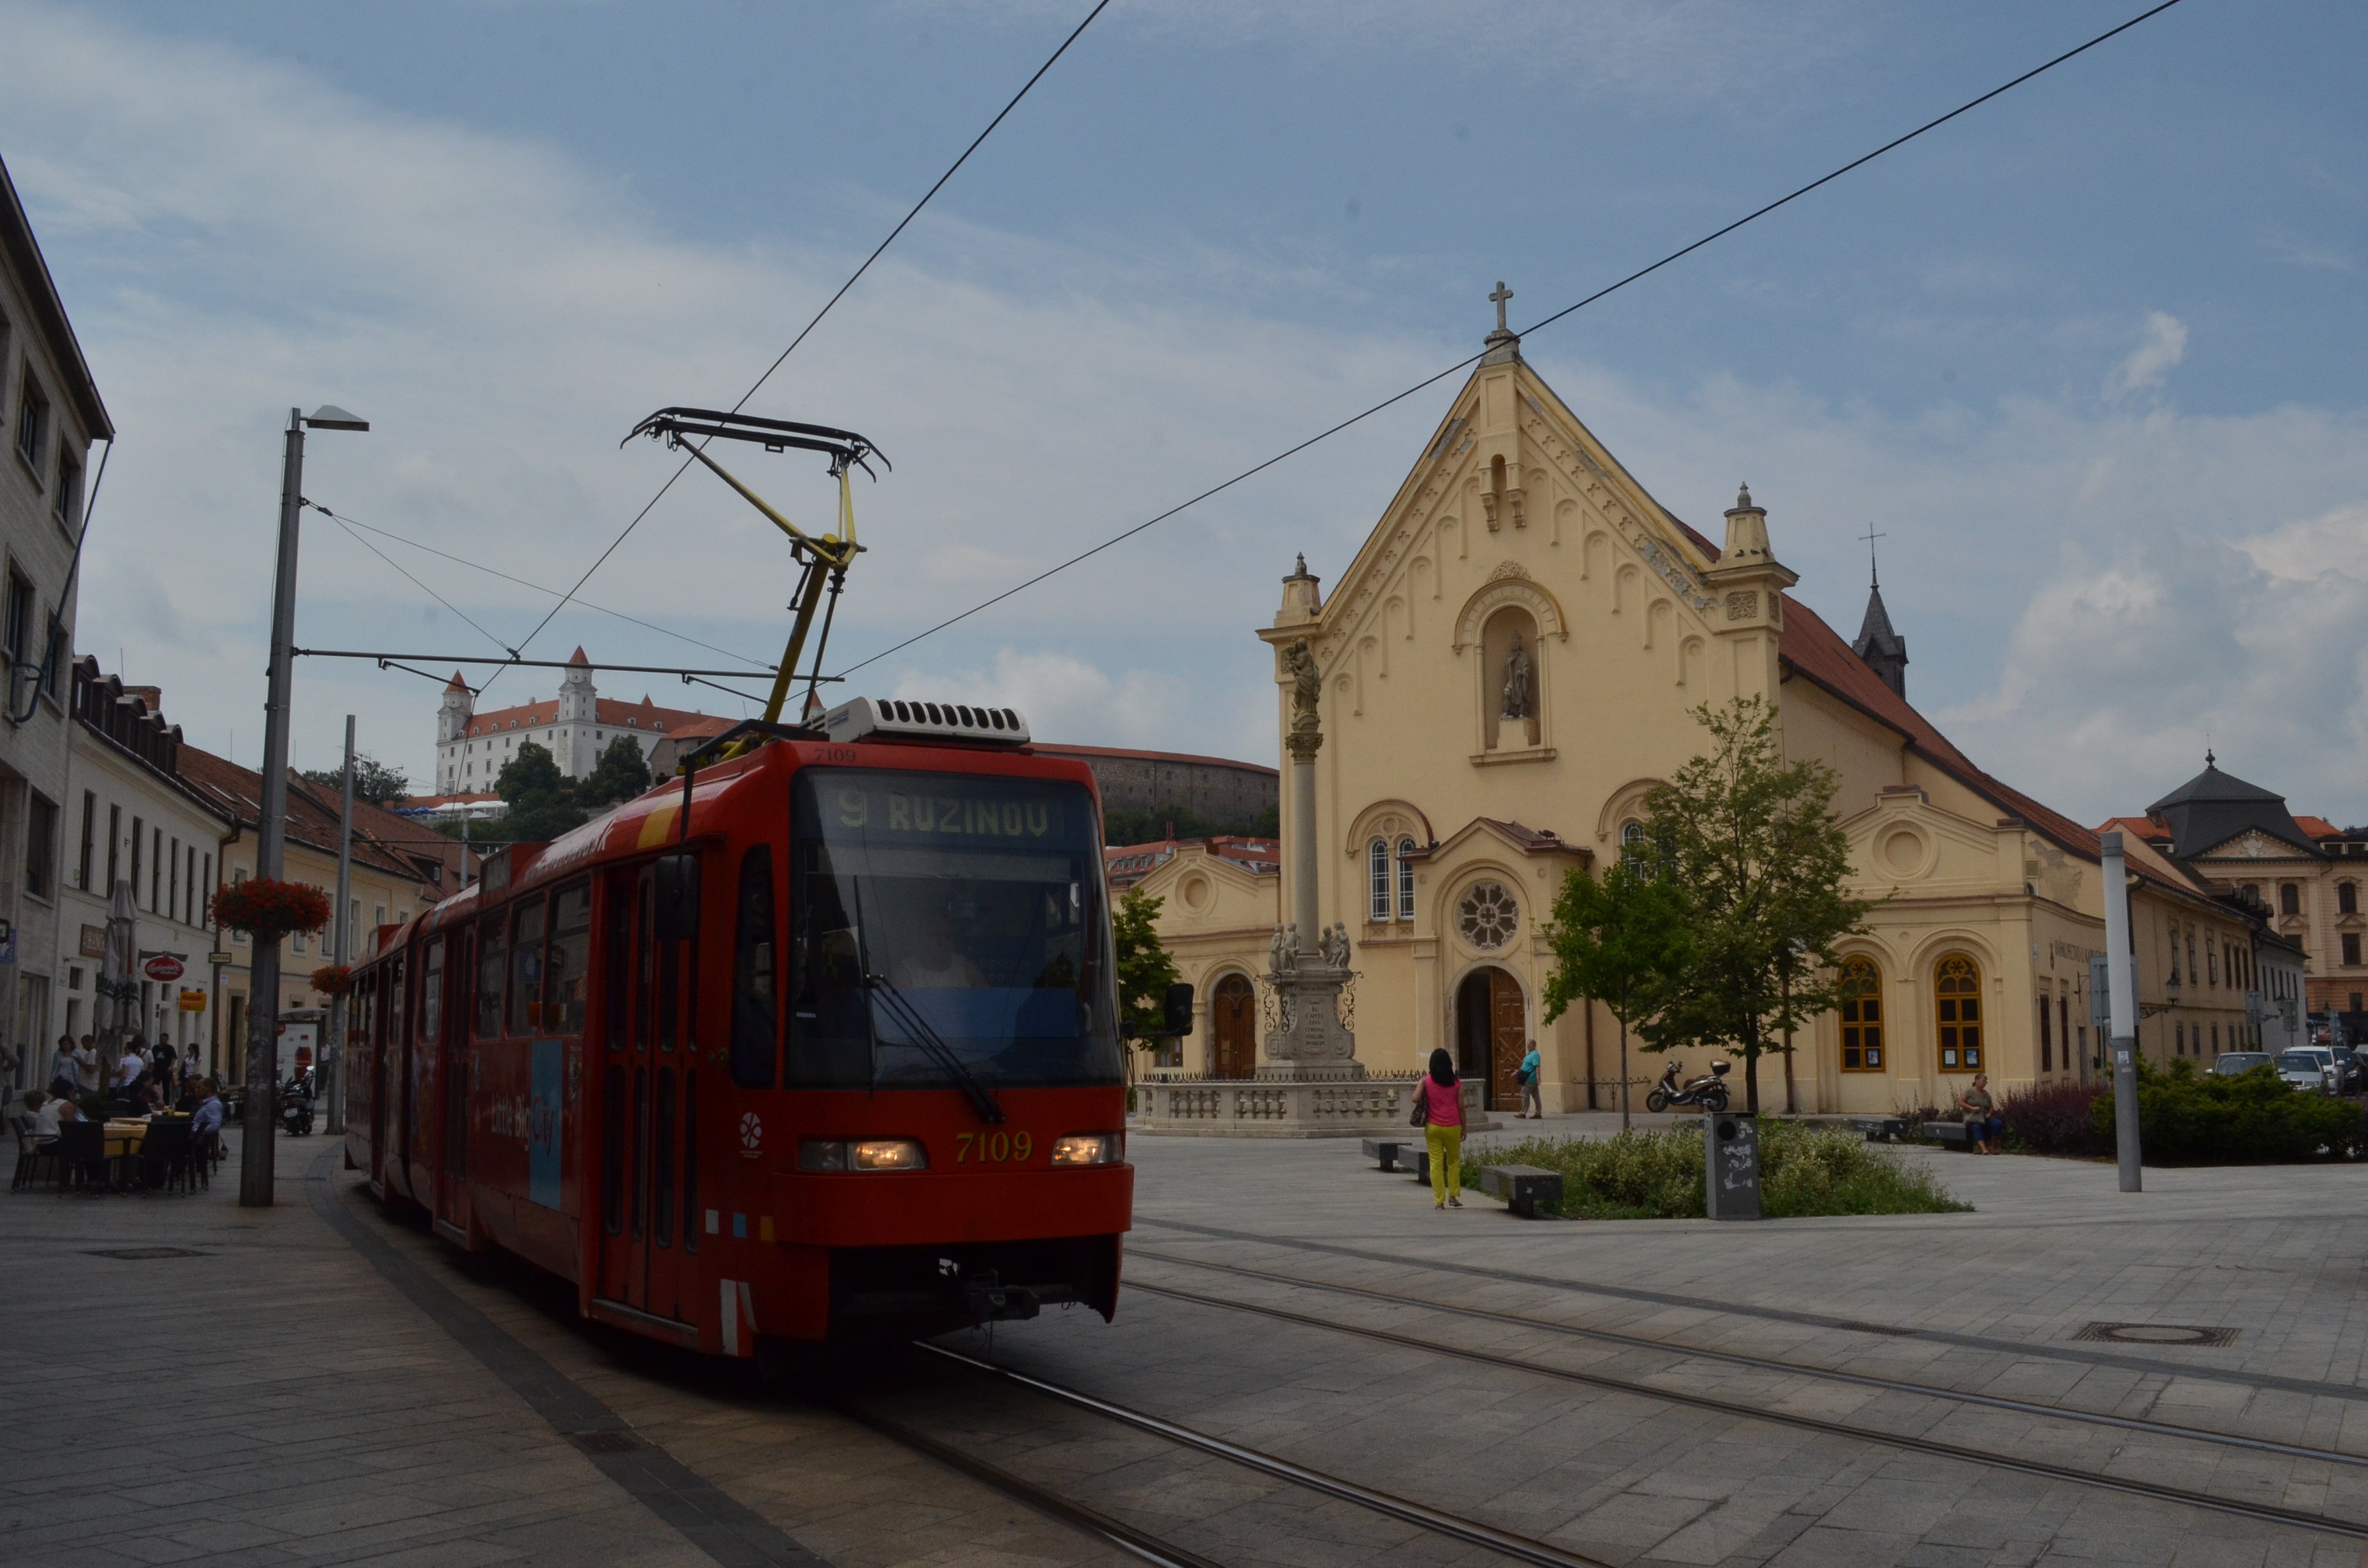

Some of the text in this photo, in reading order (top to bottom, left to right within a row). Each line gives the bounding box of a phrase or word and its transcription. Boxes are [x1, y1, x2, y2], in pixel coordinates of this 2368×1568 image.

[814, 748, 857, 762] 7109
[839, 787, 867, 828] 9
[956, 1131, 1032, 1163] 7109
